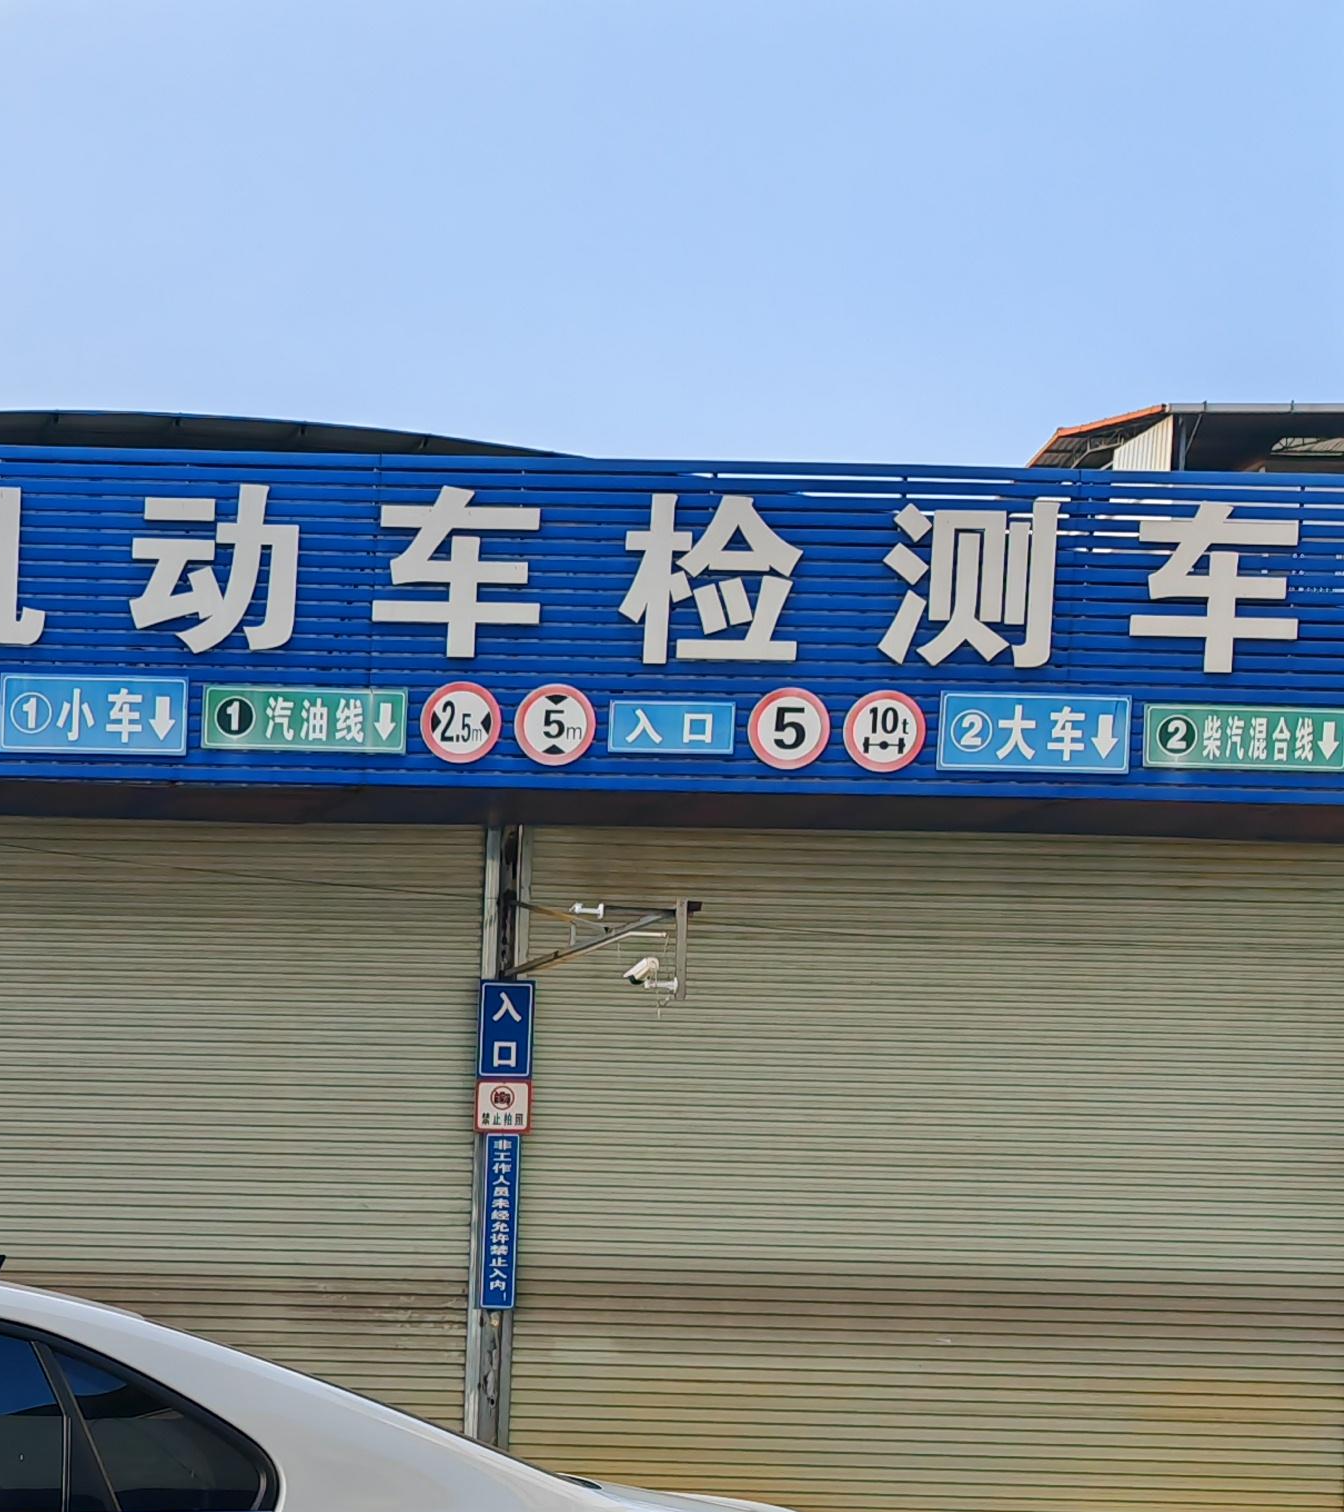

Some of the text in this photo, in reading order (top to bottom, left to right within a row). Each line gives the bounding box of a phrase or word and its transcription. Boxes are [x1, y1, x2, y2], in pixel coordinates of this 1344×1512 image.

[440, 700, 483, 743] 2.5m
[543, 709, 582, 740] 5m
[625, 708, 713, 744] 入口
[773, 706, 806, 750] 5
[869, 706, 909, 735] 10t
[492, 991, 522, 1068] 入口
[482, 1112, 524, 1126] 禁止拍照
